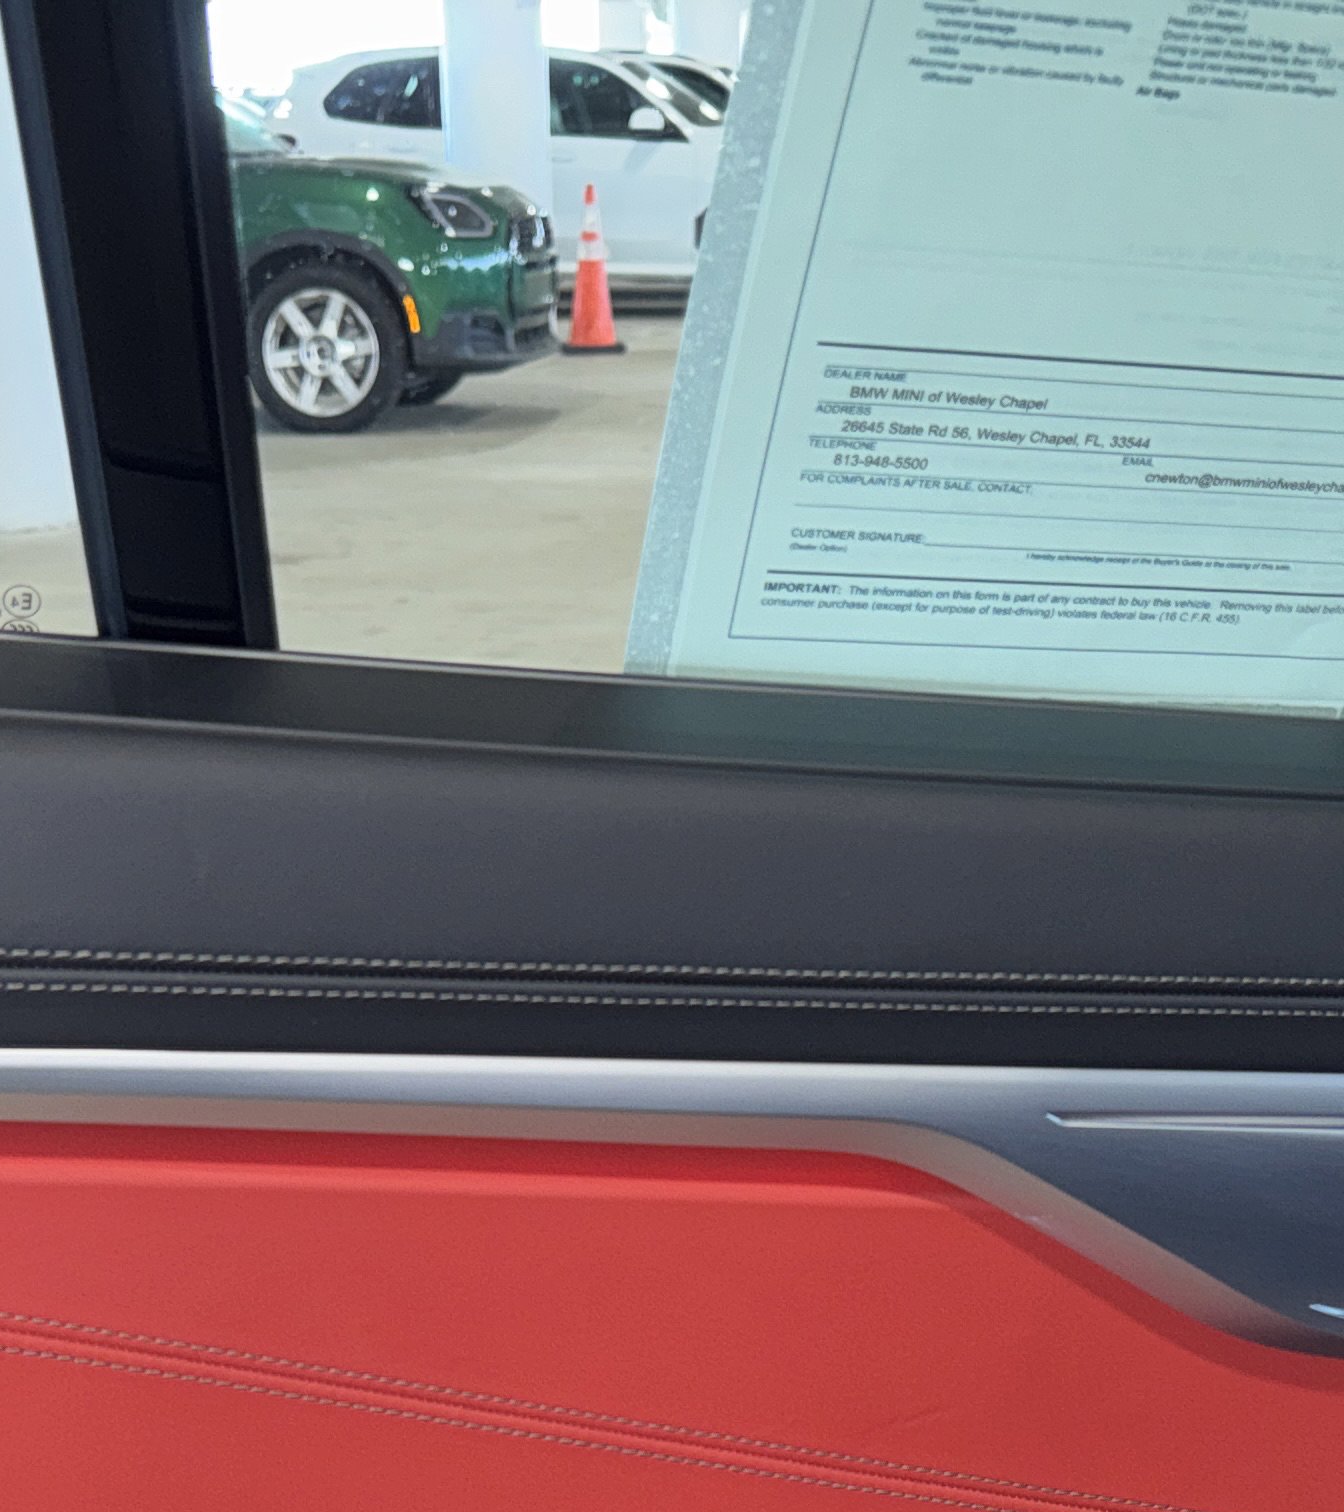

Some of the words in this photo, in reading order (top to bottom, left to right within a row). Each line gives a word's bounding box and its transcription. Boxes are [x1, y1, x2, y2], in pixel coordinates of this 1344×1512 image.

[824, 369, 872, 379] DEALER
[874, 372, 906, 382] NAME
[850, 386, 888, 399] BMW
[892, 389, 924, 402] MINI
[928, 391, 943, 402] of
[946, 392, 996, 408] Wesley
[1000, 395, 1048, 410] Chapel
[816, 405, 871, 416] ADDRESS
[841, 420, 884, 433] 26645
[889, 422, 924, 436] State
[928, 425, 948, 437] Rd
[952, 427, 971, 440] 56,
[978, 428, 1025, 444] Wesley
[1030, 431, 1078, 446] Chapel,
[1085, 434, 1104, 448] FL,
[1110, 436, 1150, 448] 33544
[810, 439, 877, 451] TELEPHONE
[834, 454, 928, 470] 813-948-5500
[1122, 457, 1153, 467] EMAIL
[800, 473, 824, 482] FOR
[827, 475, 900, 487] COMPLAINTS
[903, 479, 941, 489] AFTER
[792, 528, 855, 540] CUSTOMER
[764, 582, 842, 594] IMPORTANT:
[850, 585, 869, 595] The
[872, 587, 933, 598] information
[953, 590, 971, 600] this
[975, 591, 999, 600] form
[1002, 593, 1009, 601] is
[1013, 594, 1035, 603] part
[1037, 594, 1049, 603] of
[1051, 596, 1070, 605] any
[1073, 597, 1116, 606] contract
[1118, 597, 1129, 606] to
[1131, 597, 1150, 608] buy
[1153, 598, 1171, 607] this
[1220, 600, 1272, 614] Removing
[1275, 604, 1292, 613] this
[1296, 605, 1321, 614] label
[761, 598, 815, 607] consumer
[818, 600, 868, 609] purchase
[872, 602, 911, 613] (except
[915, 602, 929, 612] for
[931, 605, 975, 615] purpose
[979, 605, 990, 614] of
[992, 607, 1055, 618] test-driving)
[1058, 610, 1096, 619] violates
[1100, 610, 1136, 620] federal
[1139, 612, 1155, 620] law
[1159, 612, 1176, 622] (16
